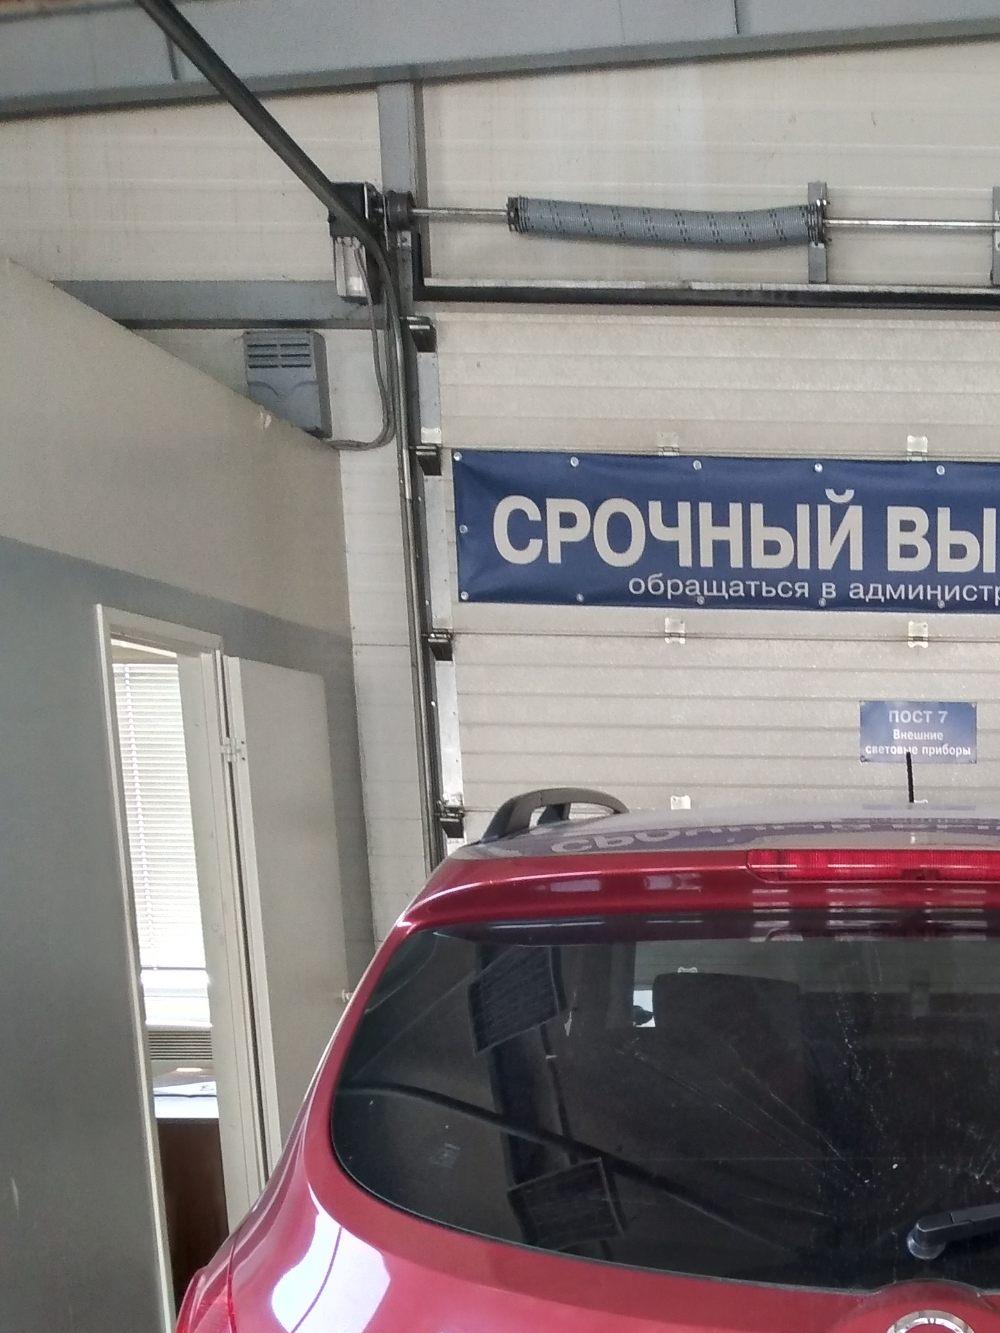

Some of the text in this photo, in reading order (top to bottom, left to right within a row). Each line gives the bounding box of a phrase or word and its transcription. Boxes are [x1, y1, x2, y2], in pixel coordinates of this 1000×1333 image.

[493, 489, 864, 572] СРОЧНЫЙ
[628, 572, 809, 600] обращаться
[822, 583, 837, 599] в
[888, 709, 949, 724] ПОСТ 7
[892, 728, 945, 741] Внешние
[865, 743, 972, 757] световые приборы
